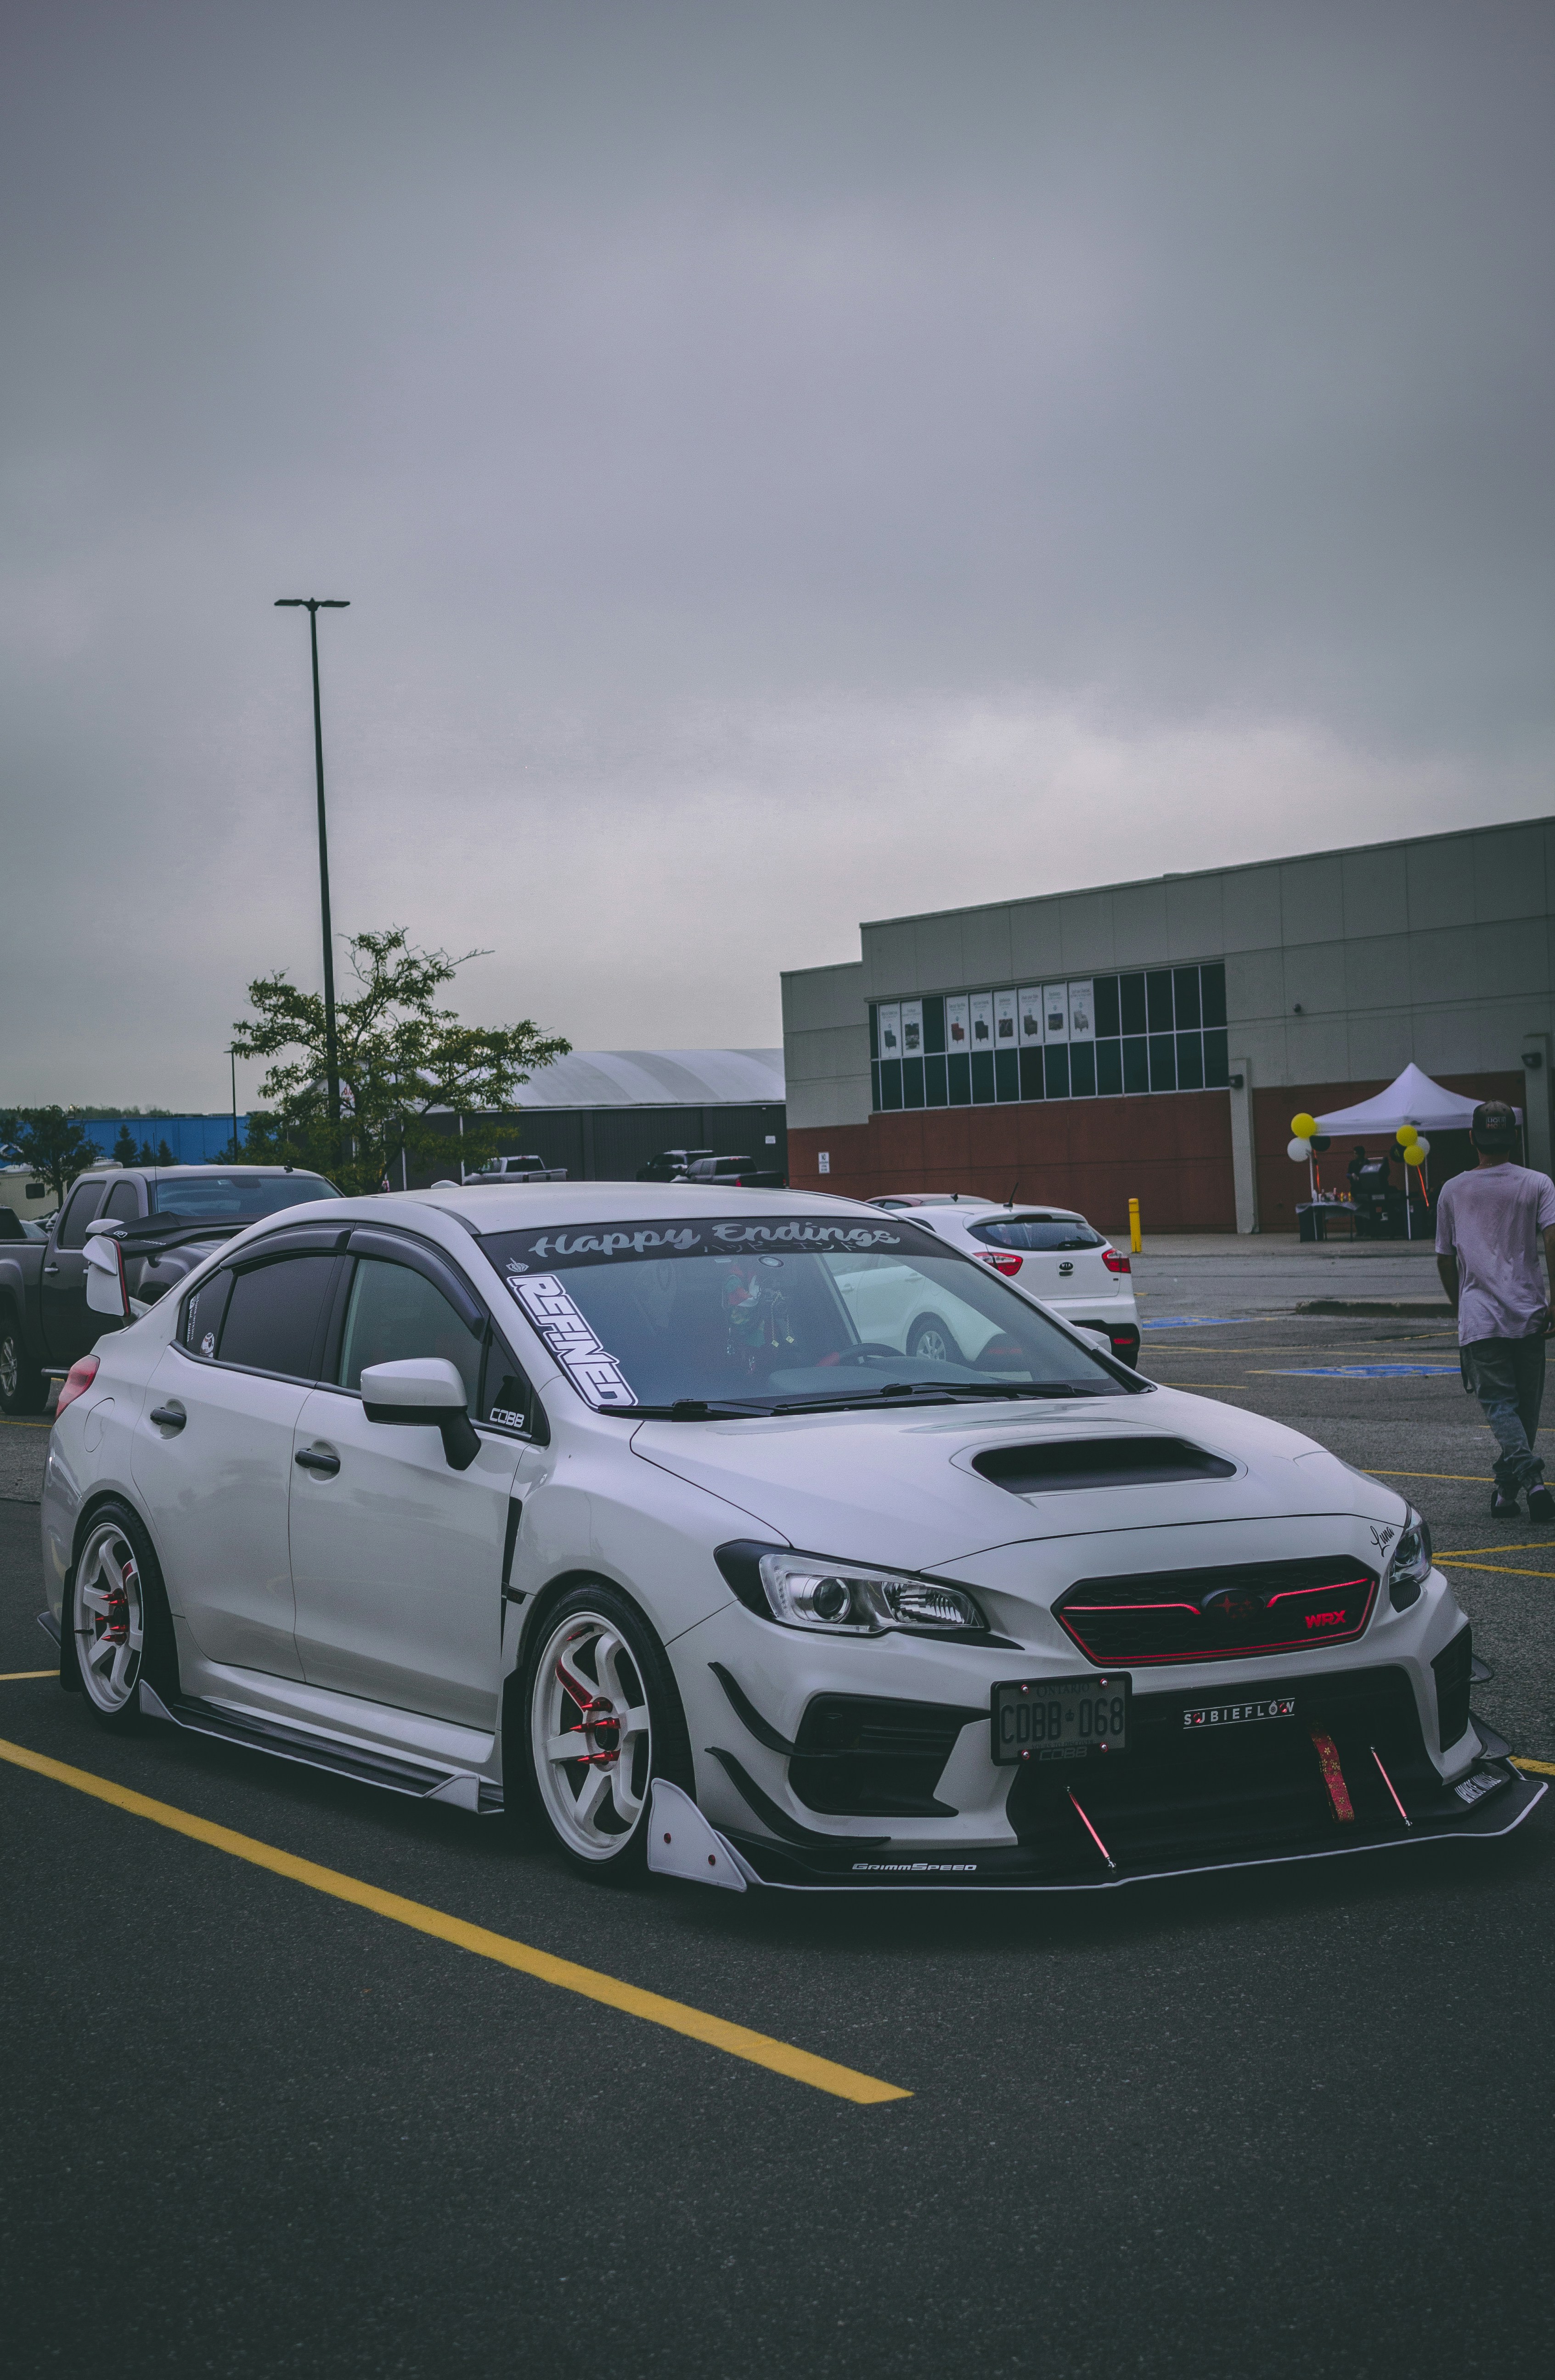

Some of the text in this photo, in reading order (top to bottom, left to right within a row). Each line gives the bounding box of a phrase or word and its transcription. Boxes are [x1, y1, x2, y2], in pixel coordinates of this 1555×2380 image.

[528, 1222, 901, 1257] Happy Endings
[508, 1275, 637, 1407] REFINED
[490, 1408, 524, 1428] COBB
[1305, 1610, 1347, 1629] WRX
[1037, 1683, 1090, 1698] ONTARIO
[1001, 1696, 1124, 1744] CDBB 068
[1039, 1746, 1087, 1761] COBB
